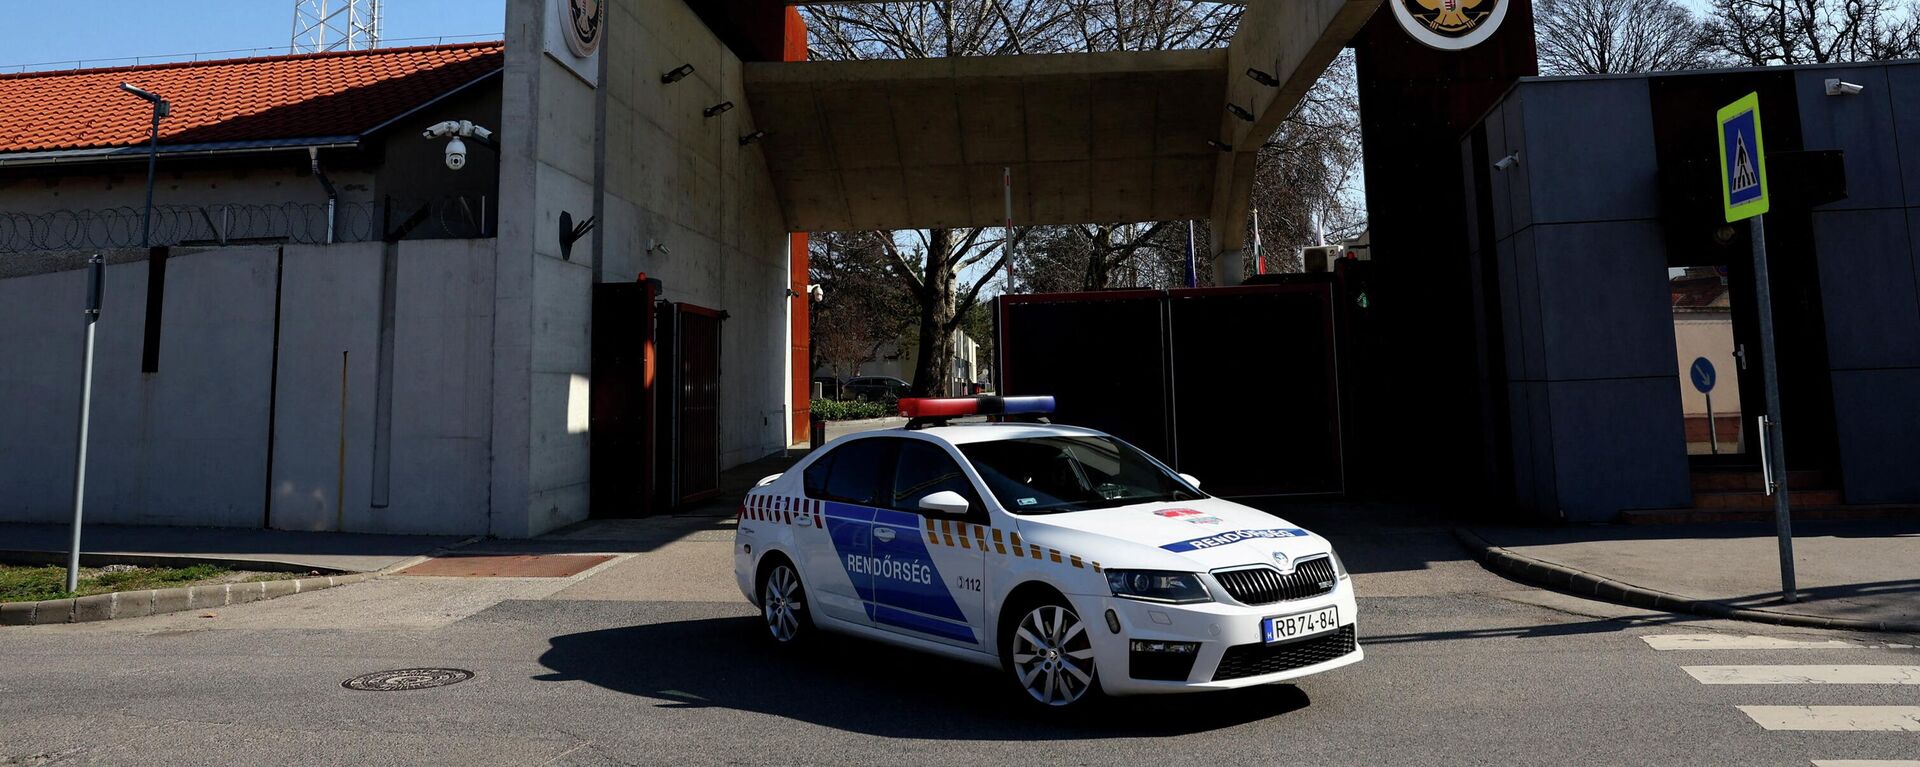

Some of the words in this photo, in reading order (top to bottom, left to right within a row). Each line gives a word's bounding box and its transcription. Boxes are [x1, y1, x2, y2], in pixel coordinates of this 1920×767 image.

[847, 554, 931, 585] RENDŐRSÉG
[965, 577, 981, 592] 112
[1275, 610, 1335, 638] RB74-84
